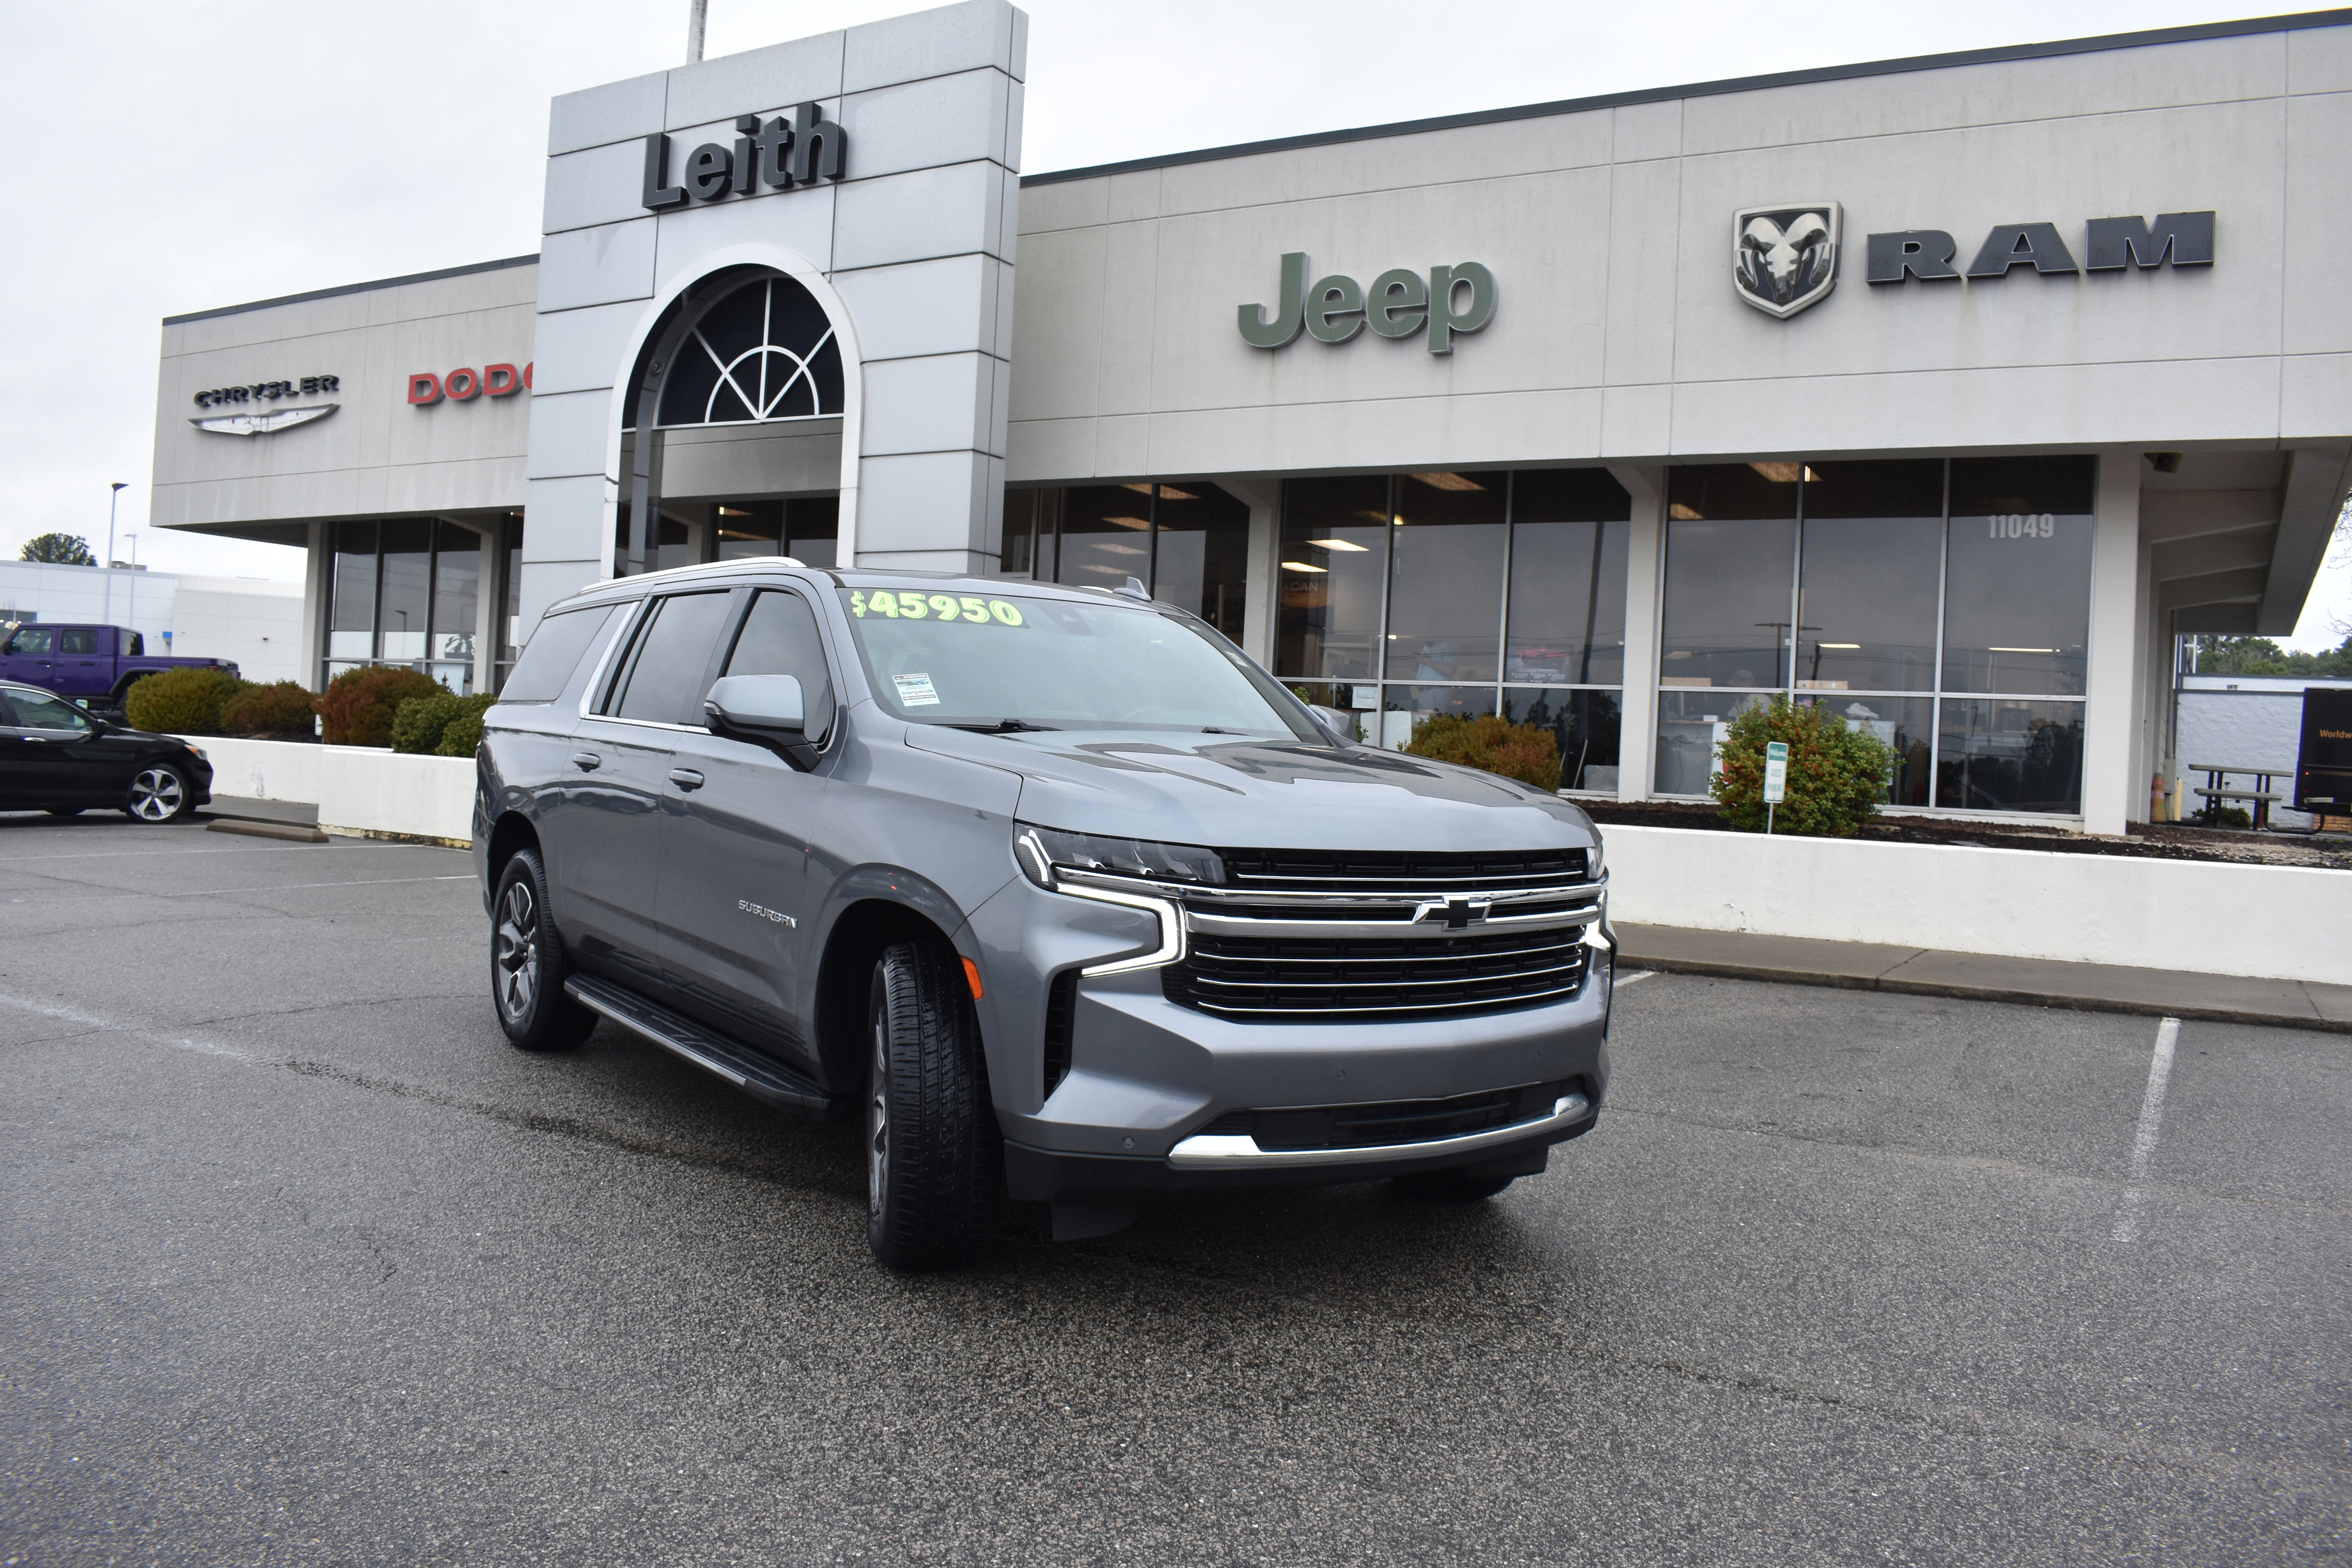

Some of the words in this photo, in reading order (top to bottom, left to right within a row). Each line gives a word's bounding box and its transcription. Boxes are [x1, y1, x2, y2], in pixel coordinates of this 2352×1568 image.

[642, 101, 847, 211] Leith
[1866, 210, 2216, 286] RAM
[1238, 252, 1499, 355] Jeep
[194, 374, 341, 408] CHRYSLER
[1988, 513, 2054, 539] 11049
[1290, 582, 1318, 591] CAN
[851, 590, 1023, 626] $45950
[2319, 729, 2352, 739] Worldw
[738, 900, 797, 929] SUBURBAN
